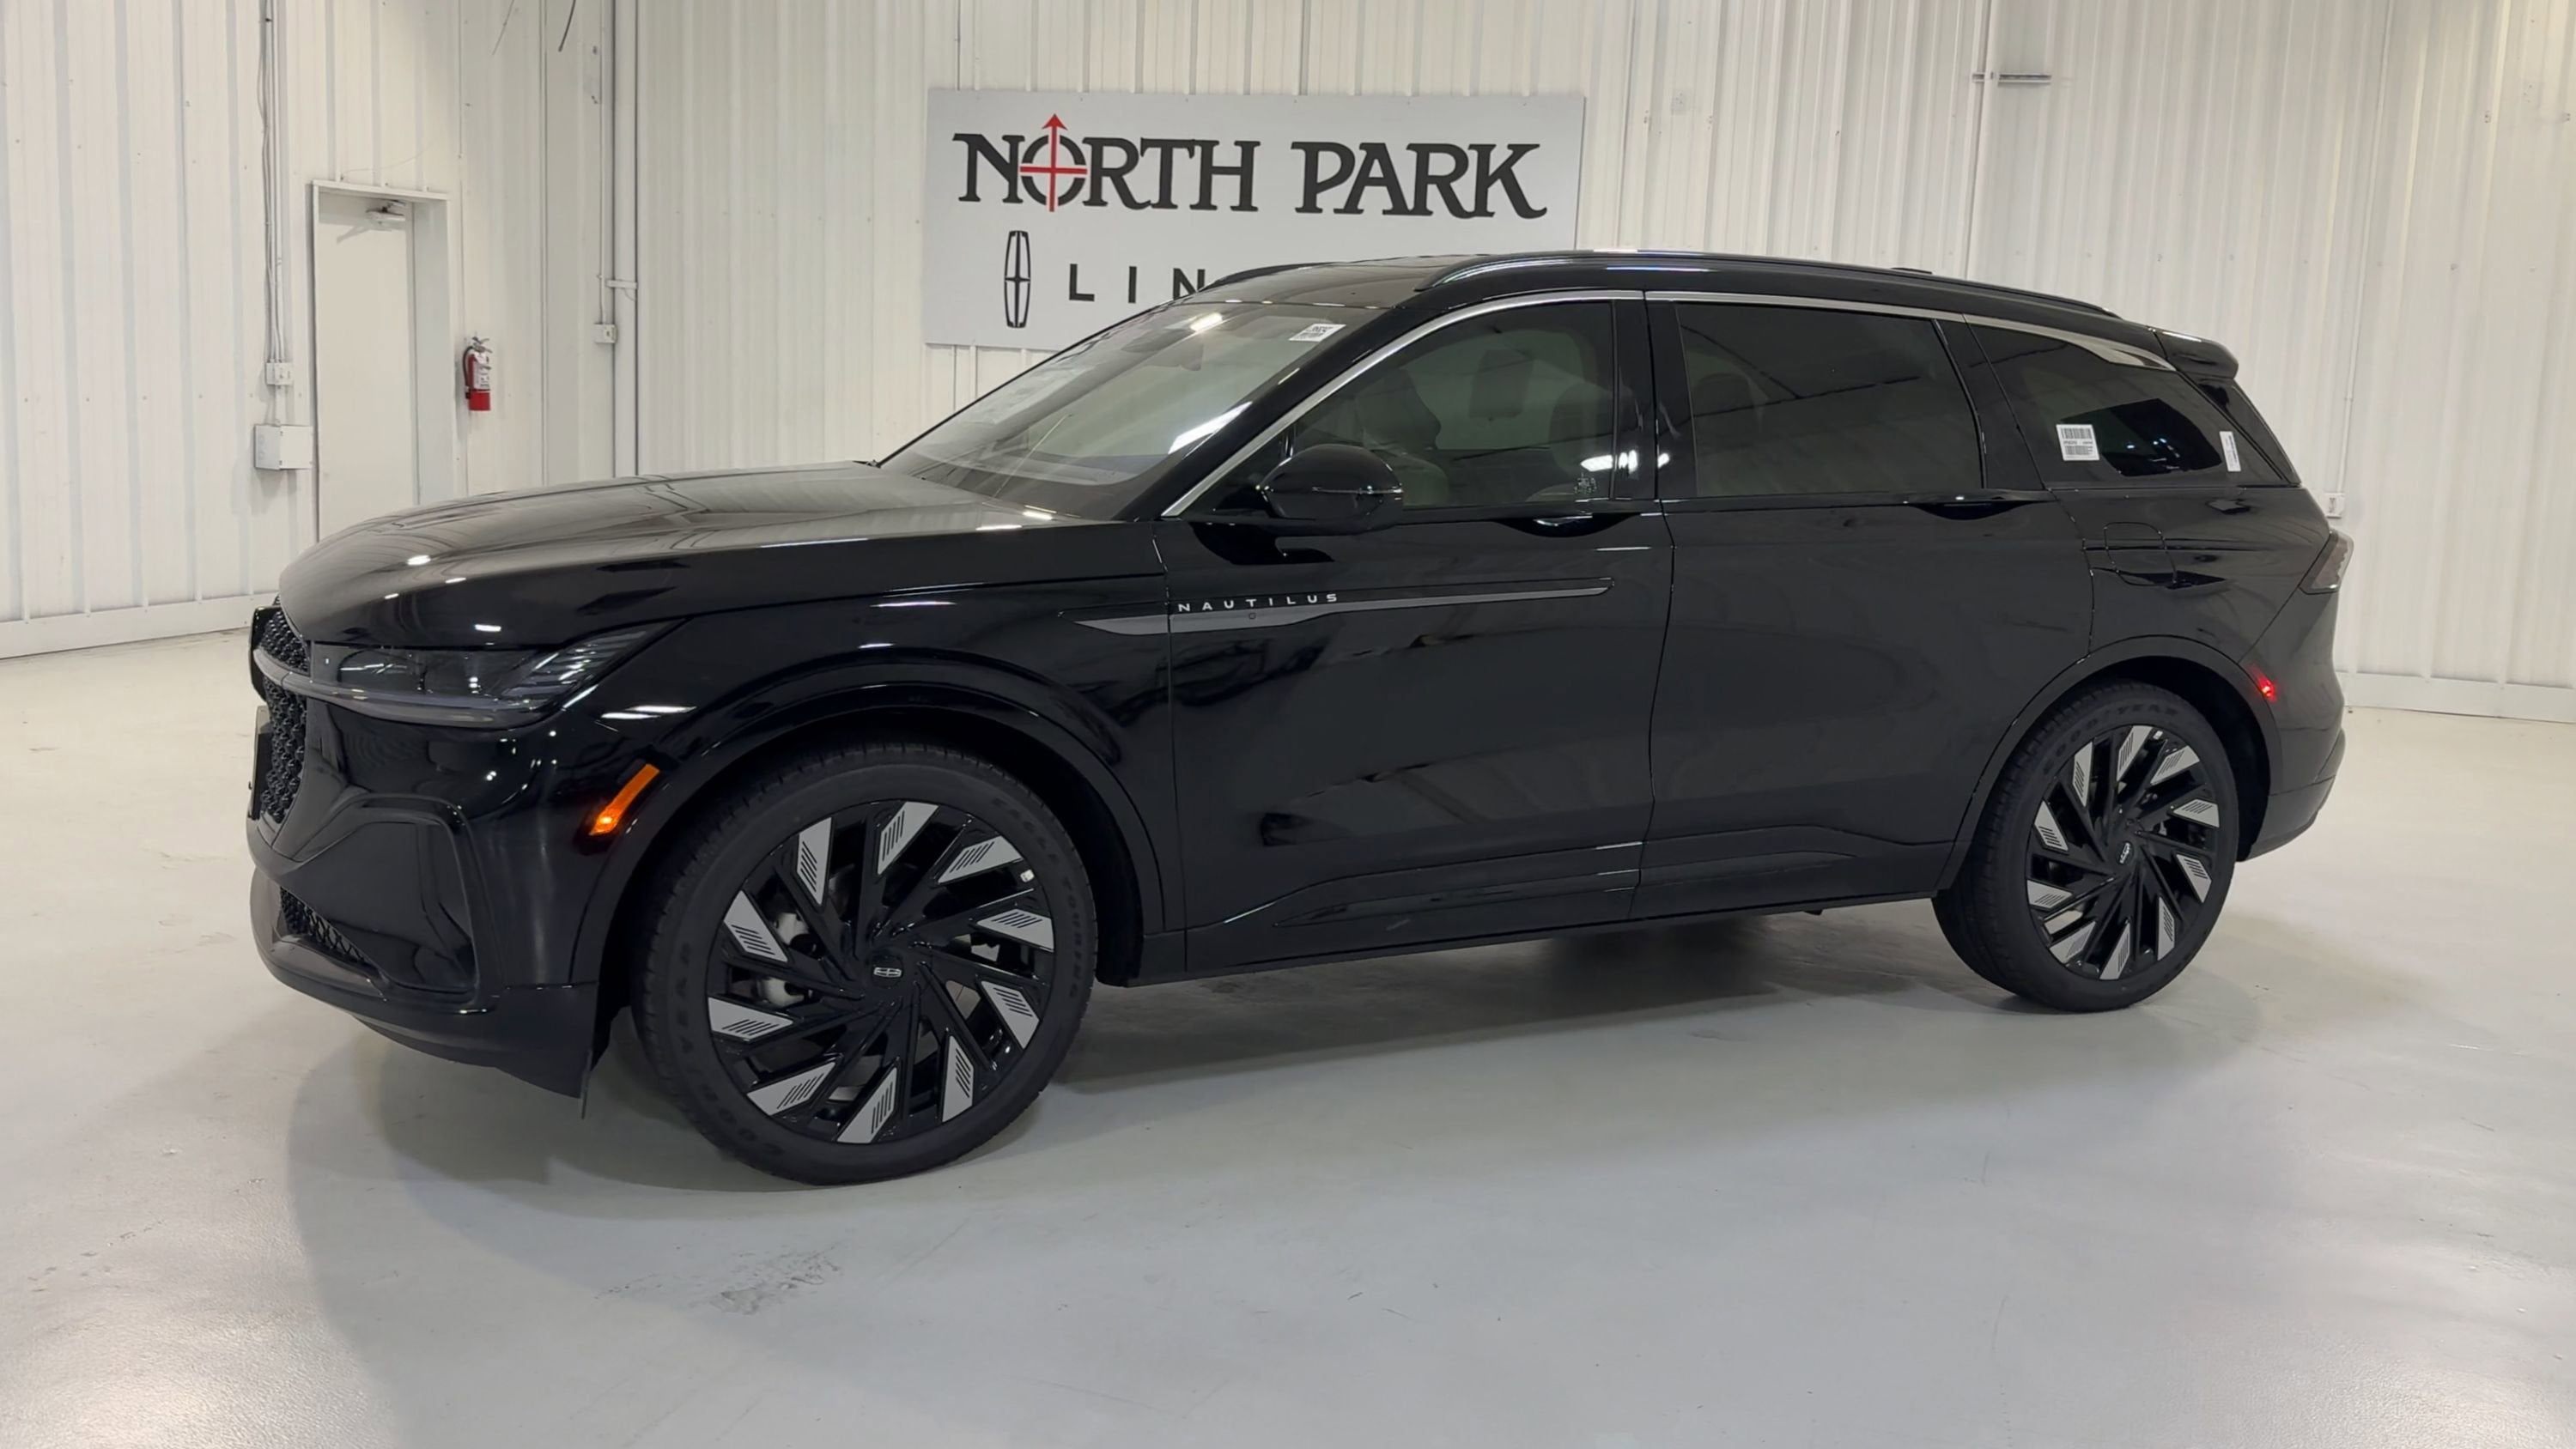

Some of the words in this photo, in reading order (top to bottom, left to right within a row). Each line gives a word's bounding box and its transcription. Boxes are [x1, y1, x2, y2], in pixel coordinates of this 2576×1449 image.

[952, 129, 1261, 213] NORTH
[1291, 141, 1548, 219] PARK
[1177, 592, 1339, 613] NAUTILUS
